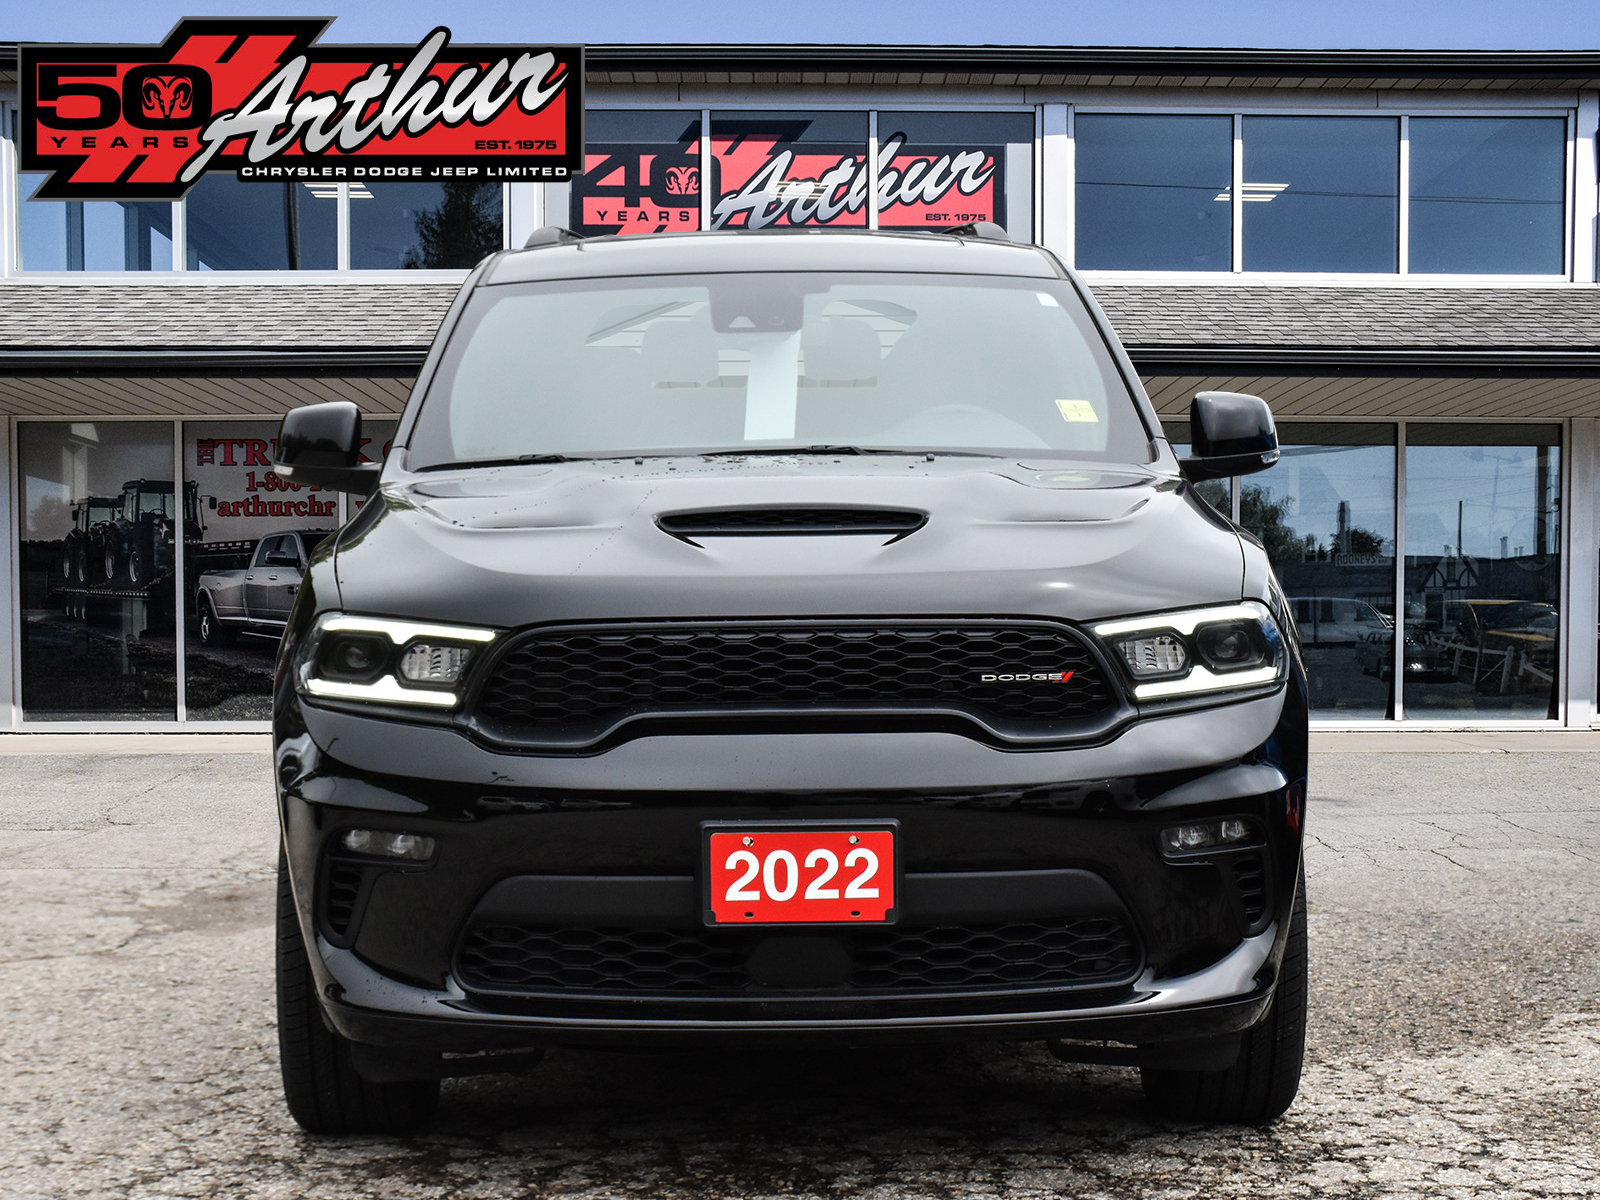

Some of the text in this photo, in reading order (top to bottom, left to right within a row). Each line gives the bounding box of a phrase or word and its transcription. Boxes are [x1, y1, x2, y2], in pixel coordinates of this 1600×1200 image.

[582, 154, 721, 208] 40
[711, 132, 996, 230] Arthur
[596, 211, 690, 222] YEARS
[925, 213, 987, 222] EST. 1975
[197, 438, 215, 466] THE
[217, 494, 362, 517] arthurchr
[981, 673, 1063, 682] DODGE
[725, 847, 880, 902] 2022
